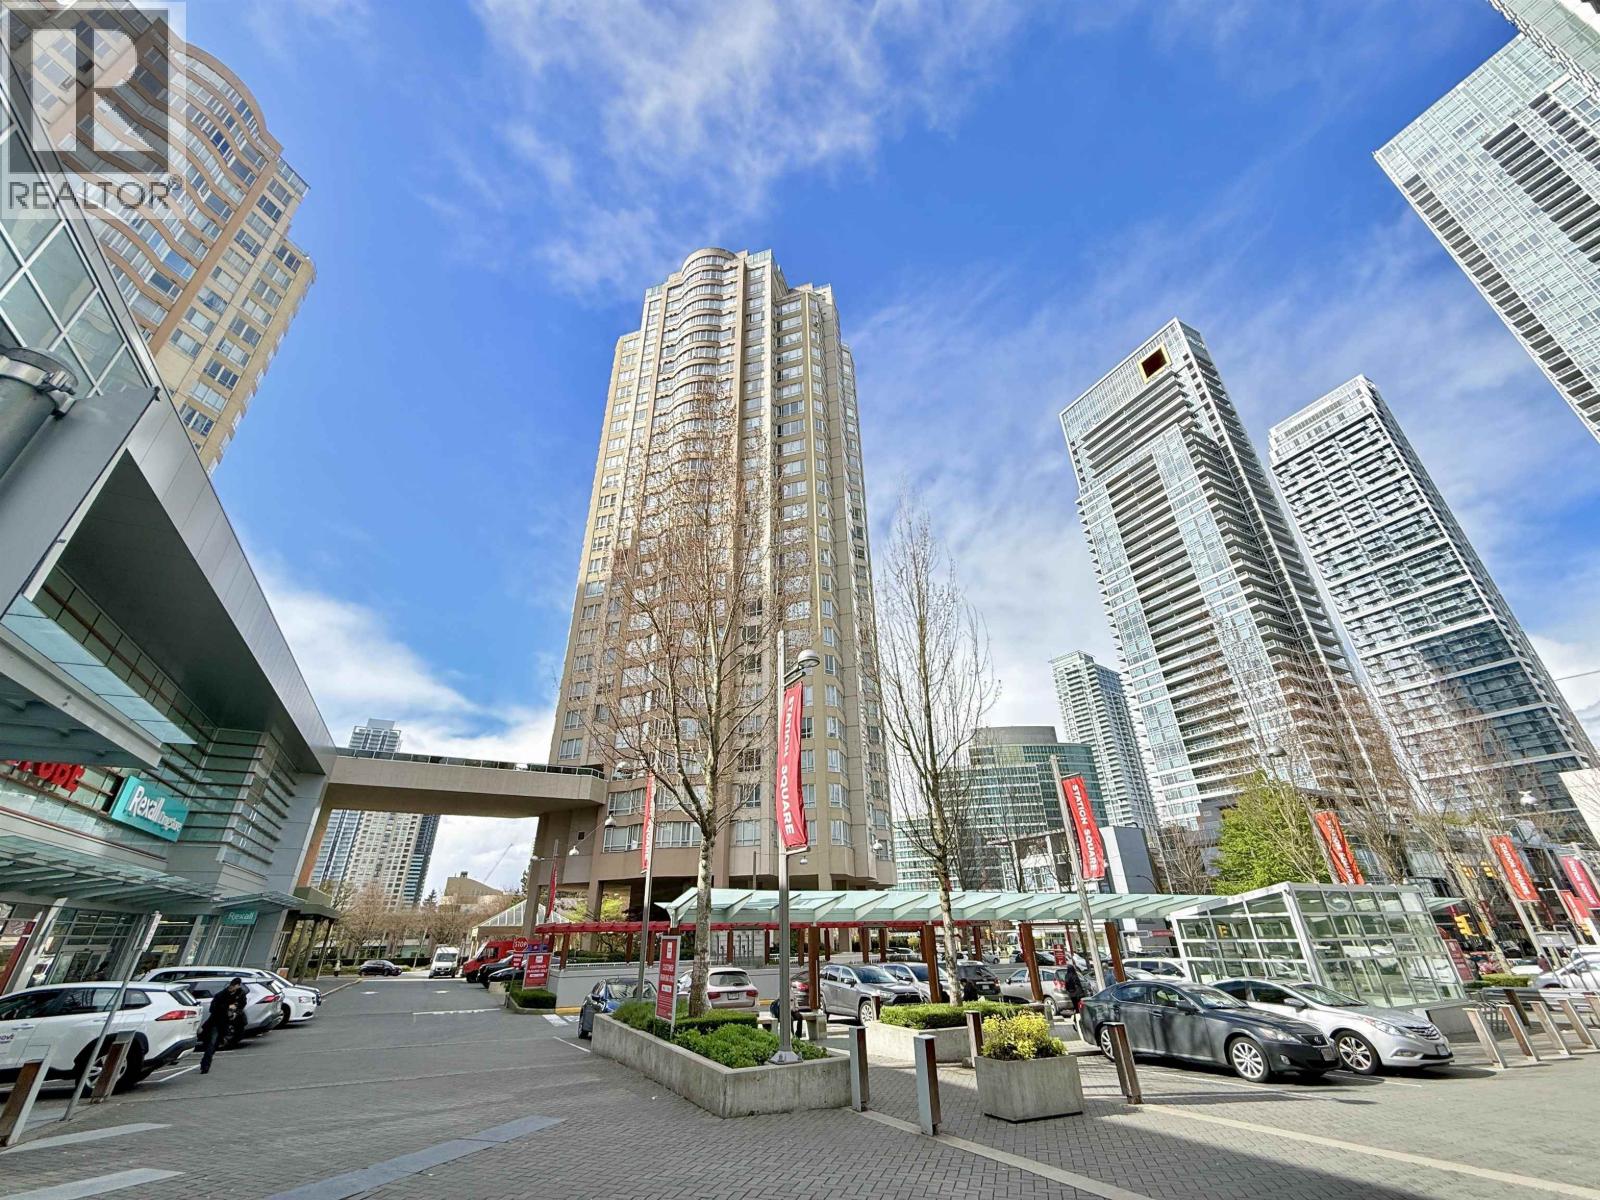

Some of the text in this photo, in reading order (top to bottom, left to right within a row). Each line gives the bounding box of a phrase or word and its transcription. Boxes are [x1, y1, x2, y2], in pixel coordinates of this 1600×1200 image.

[779, 695, 795, 836] STATION SQUARE
[128, 785, 165, 822] Rexall
[1072, 783, 1098, 871] STATION SQUARE
[1500, 842, 1530, 896] STATION SQUARE
[228, 911, 255, 920] Rexall
